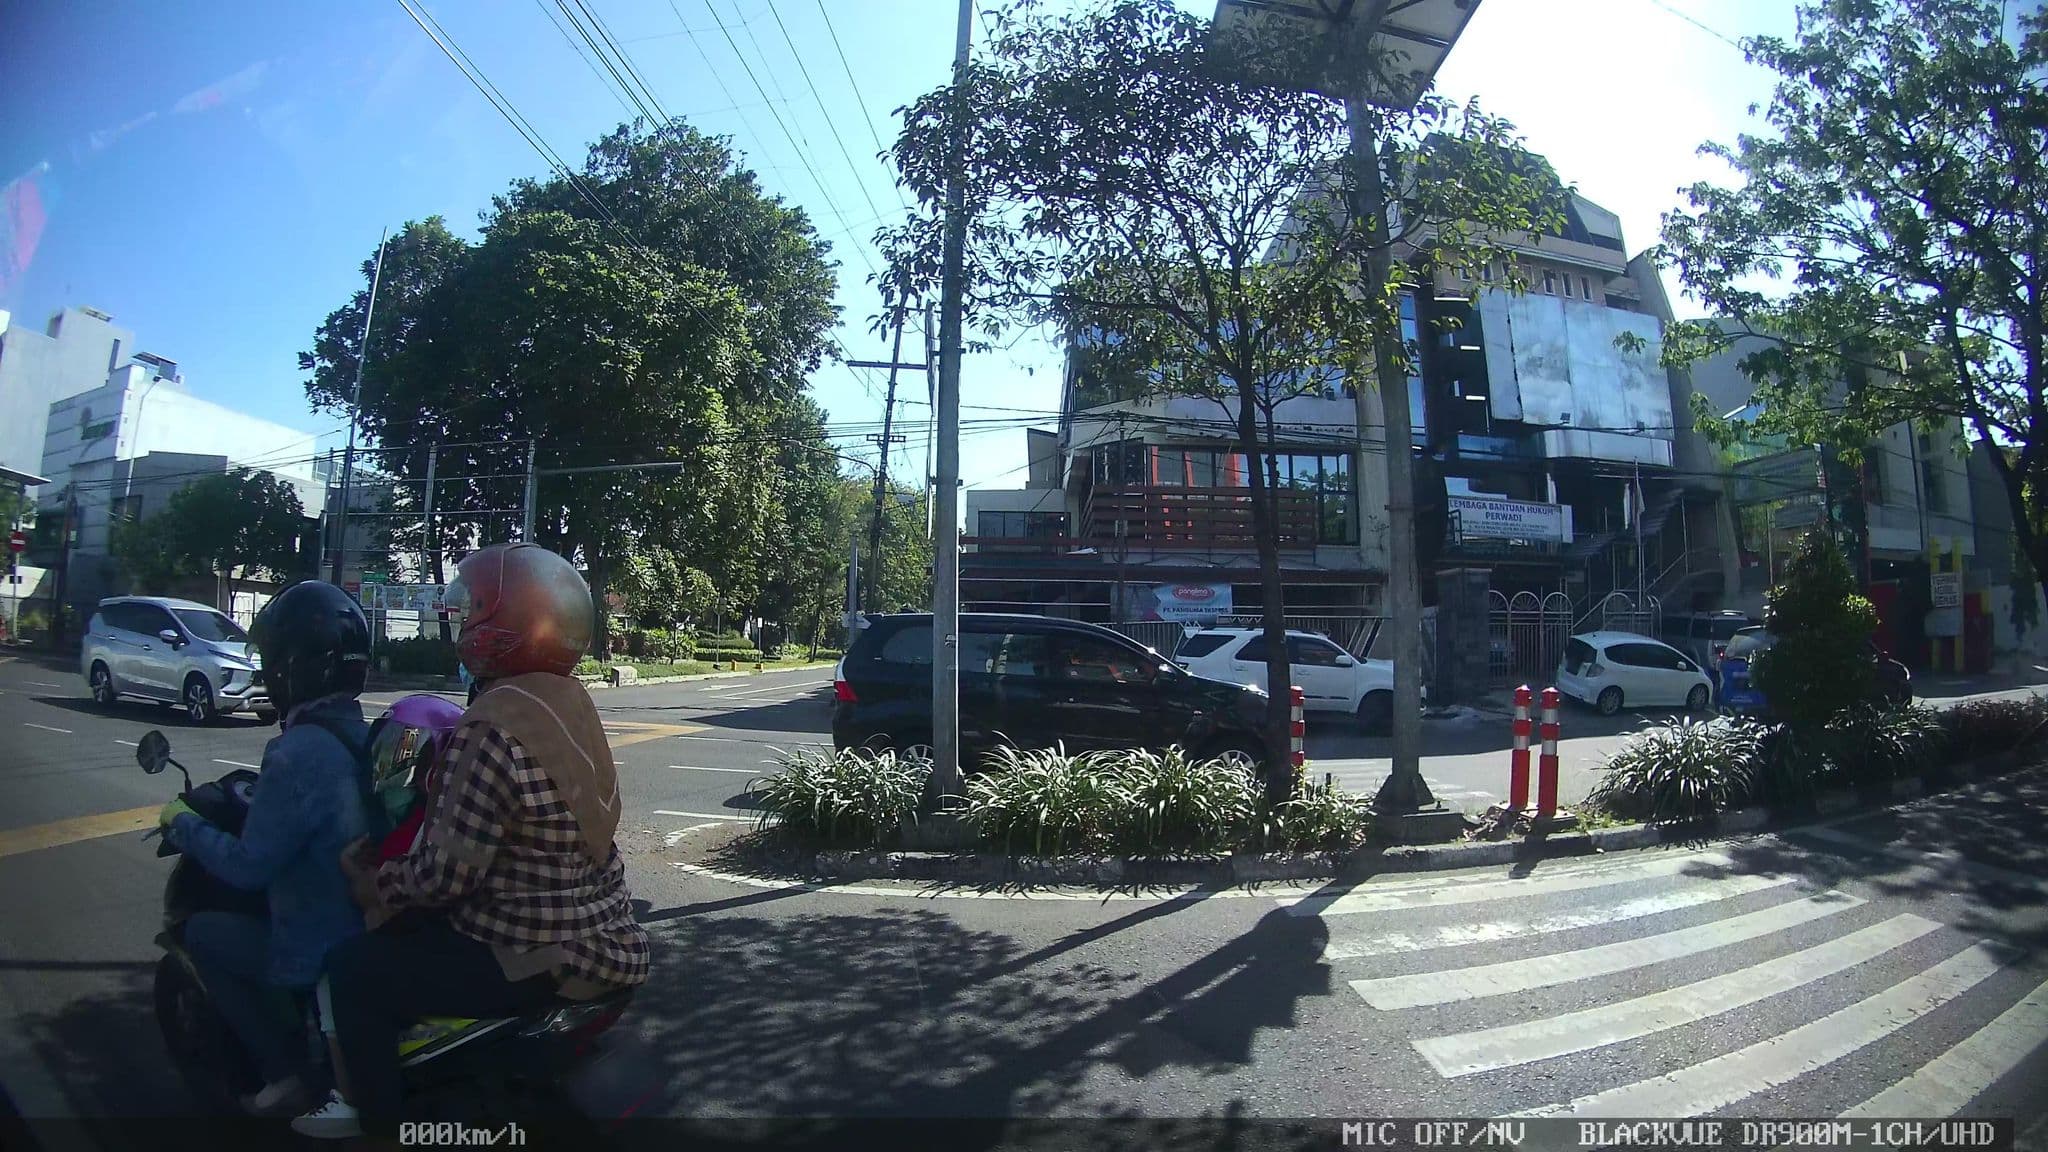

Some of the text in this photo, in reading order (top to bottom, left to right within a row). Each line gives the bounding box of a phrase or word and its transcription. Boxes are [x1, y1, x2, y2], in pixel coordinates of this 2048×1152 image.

[1449, 500, 1554, 516] LEMBAGA BANTUAN HUKUM
[1485, 511, 1522, 522] PERWADI
